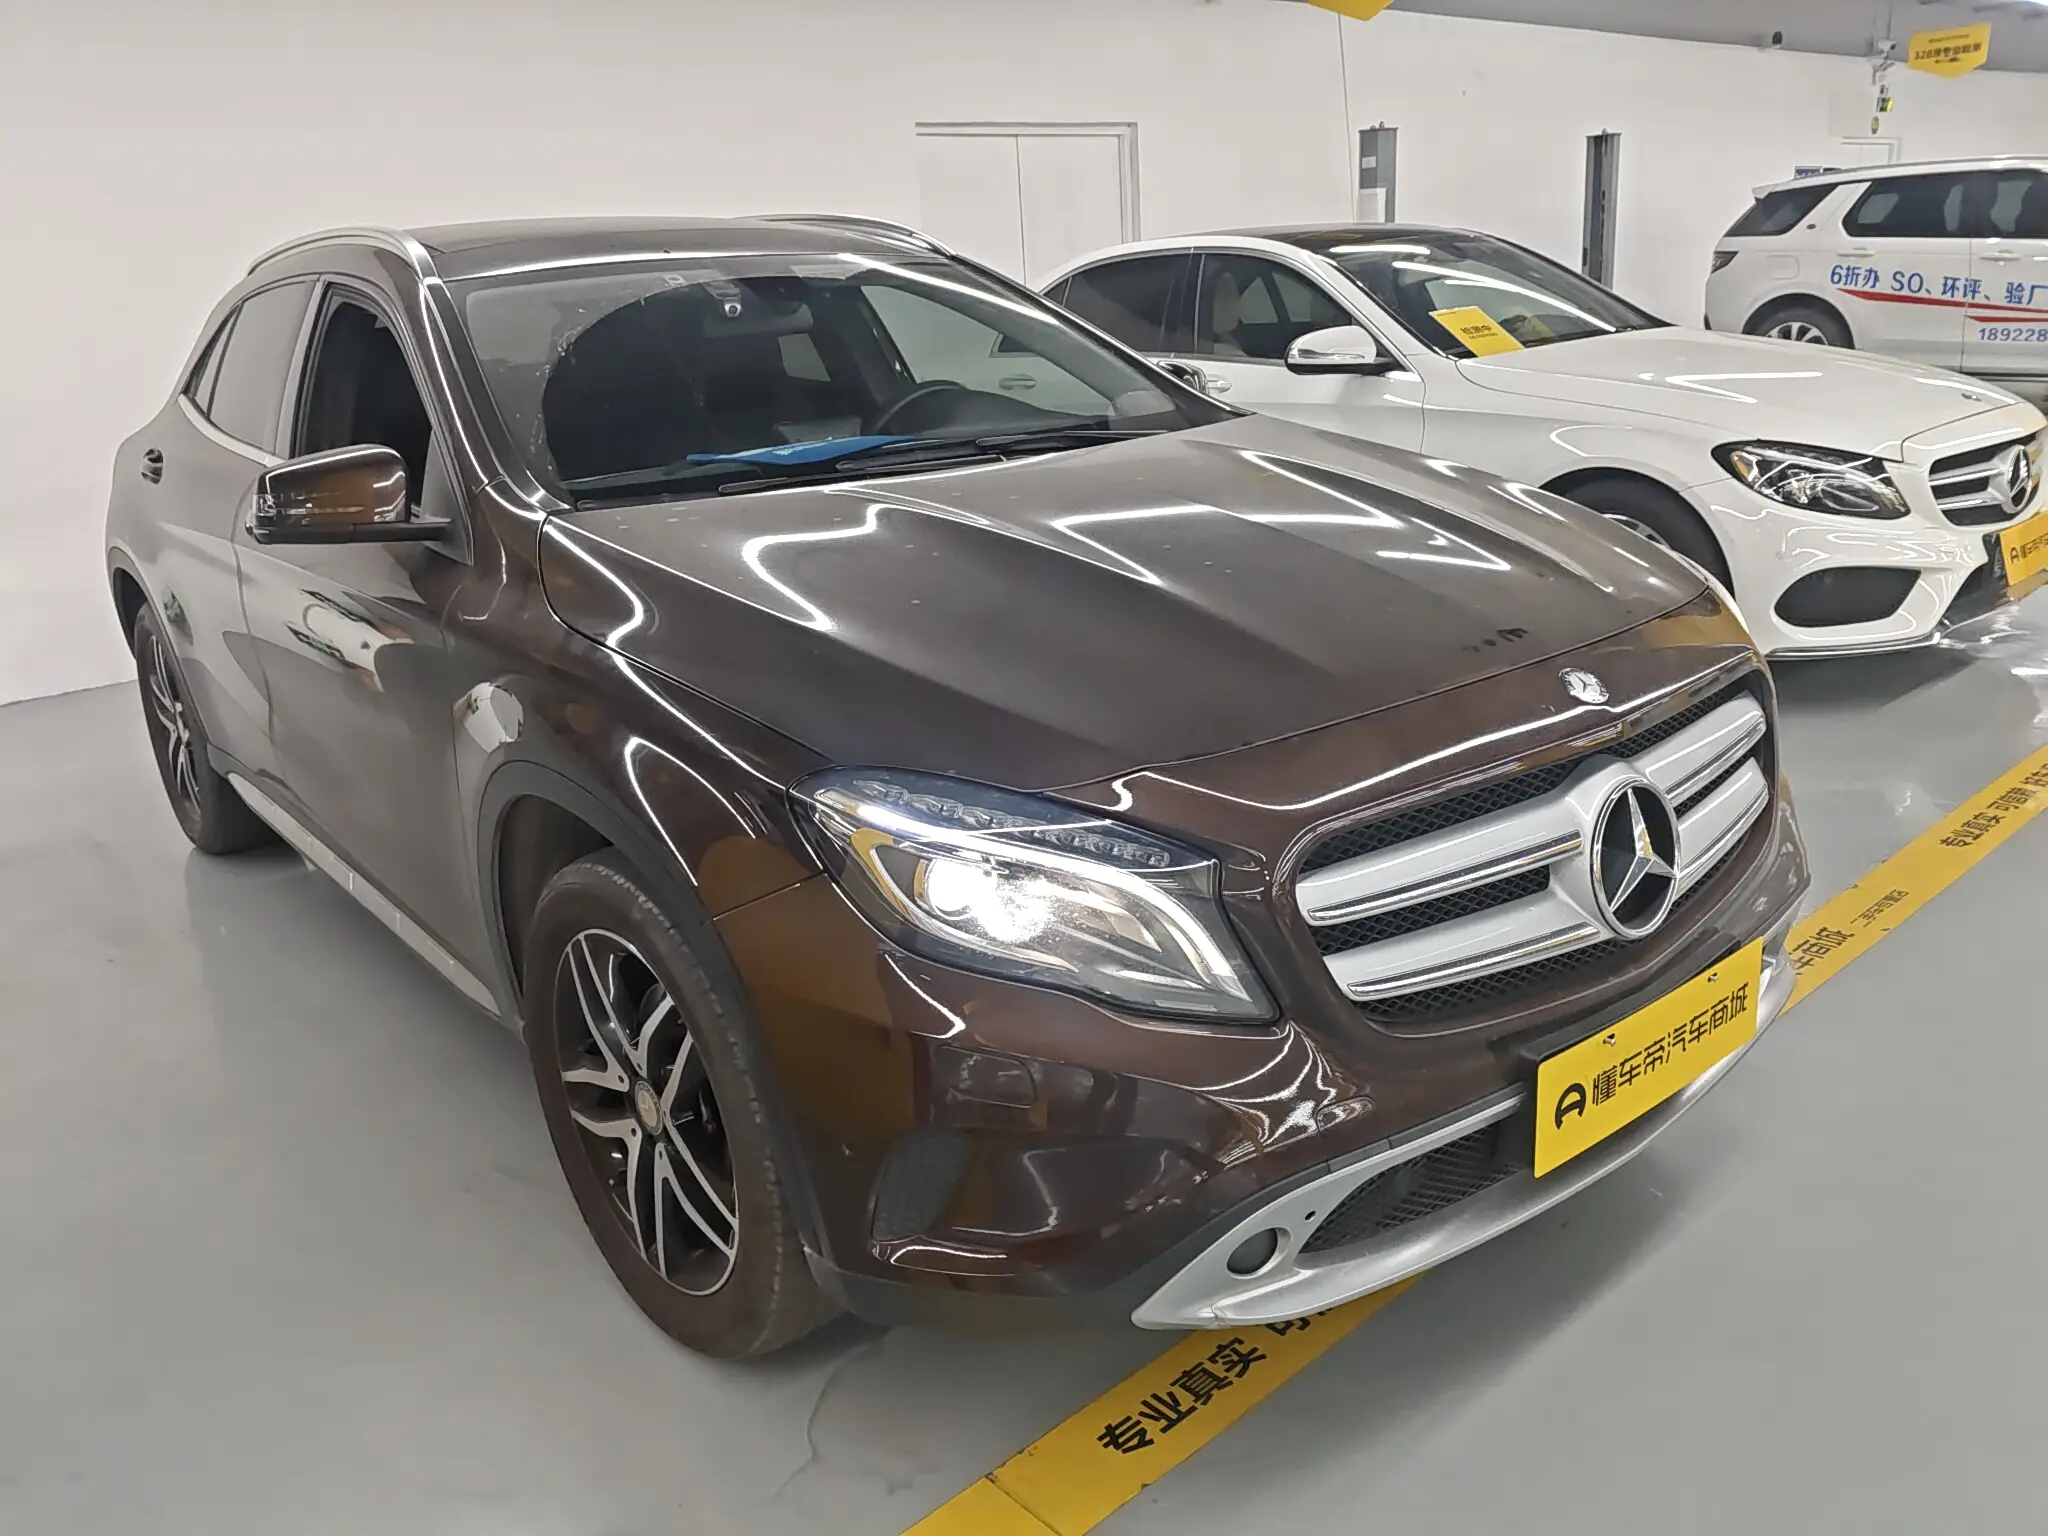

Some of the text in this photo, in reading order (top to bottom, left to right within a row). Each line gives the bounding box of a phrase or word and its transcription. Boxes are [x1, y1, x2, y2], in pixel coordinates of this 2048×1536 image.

[1830, 264, 1880, 289] 6折办
[1979, 327, 2048, 342] 189228
[1938, 811, 2007, 848] 专业真实
[1789, 926, 1856, 976] 车商城
[1592, 980, 1750, 1107] 懂车帝汽车商城
[1096, 1336, 1268, 1455] 专业真实
